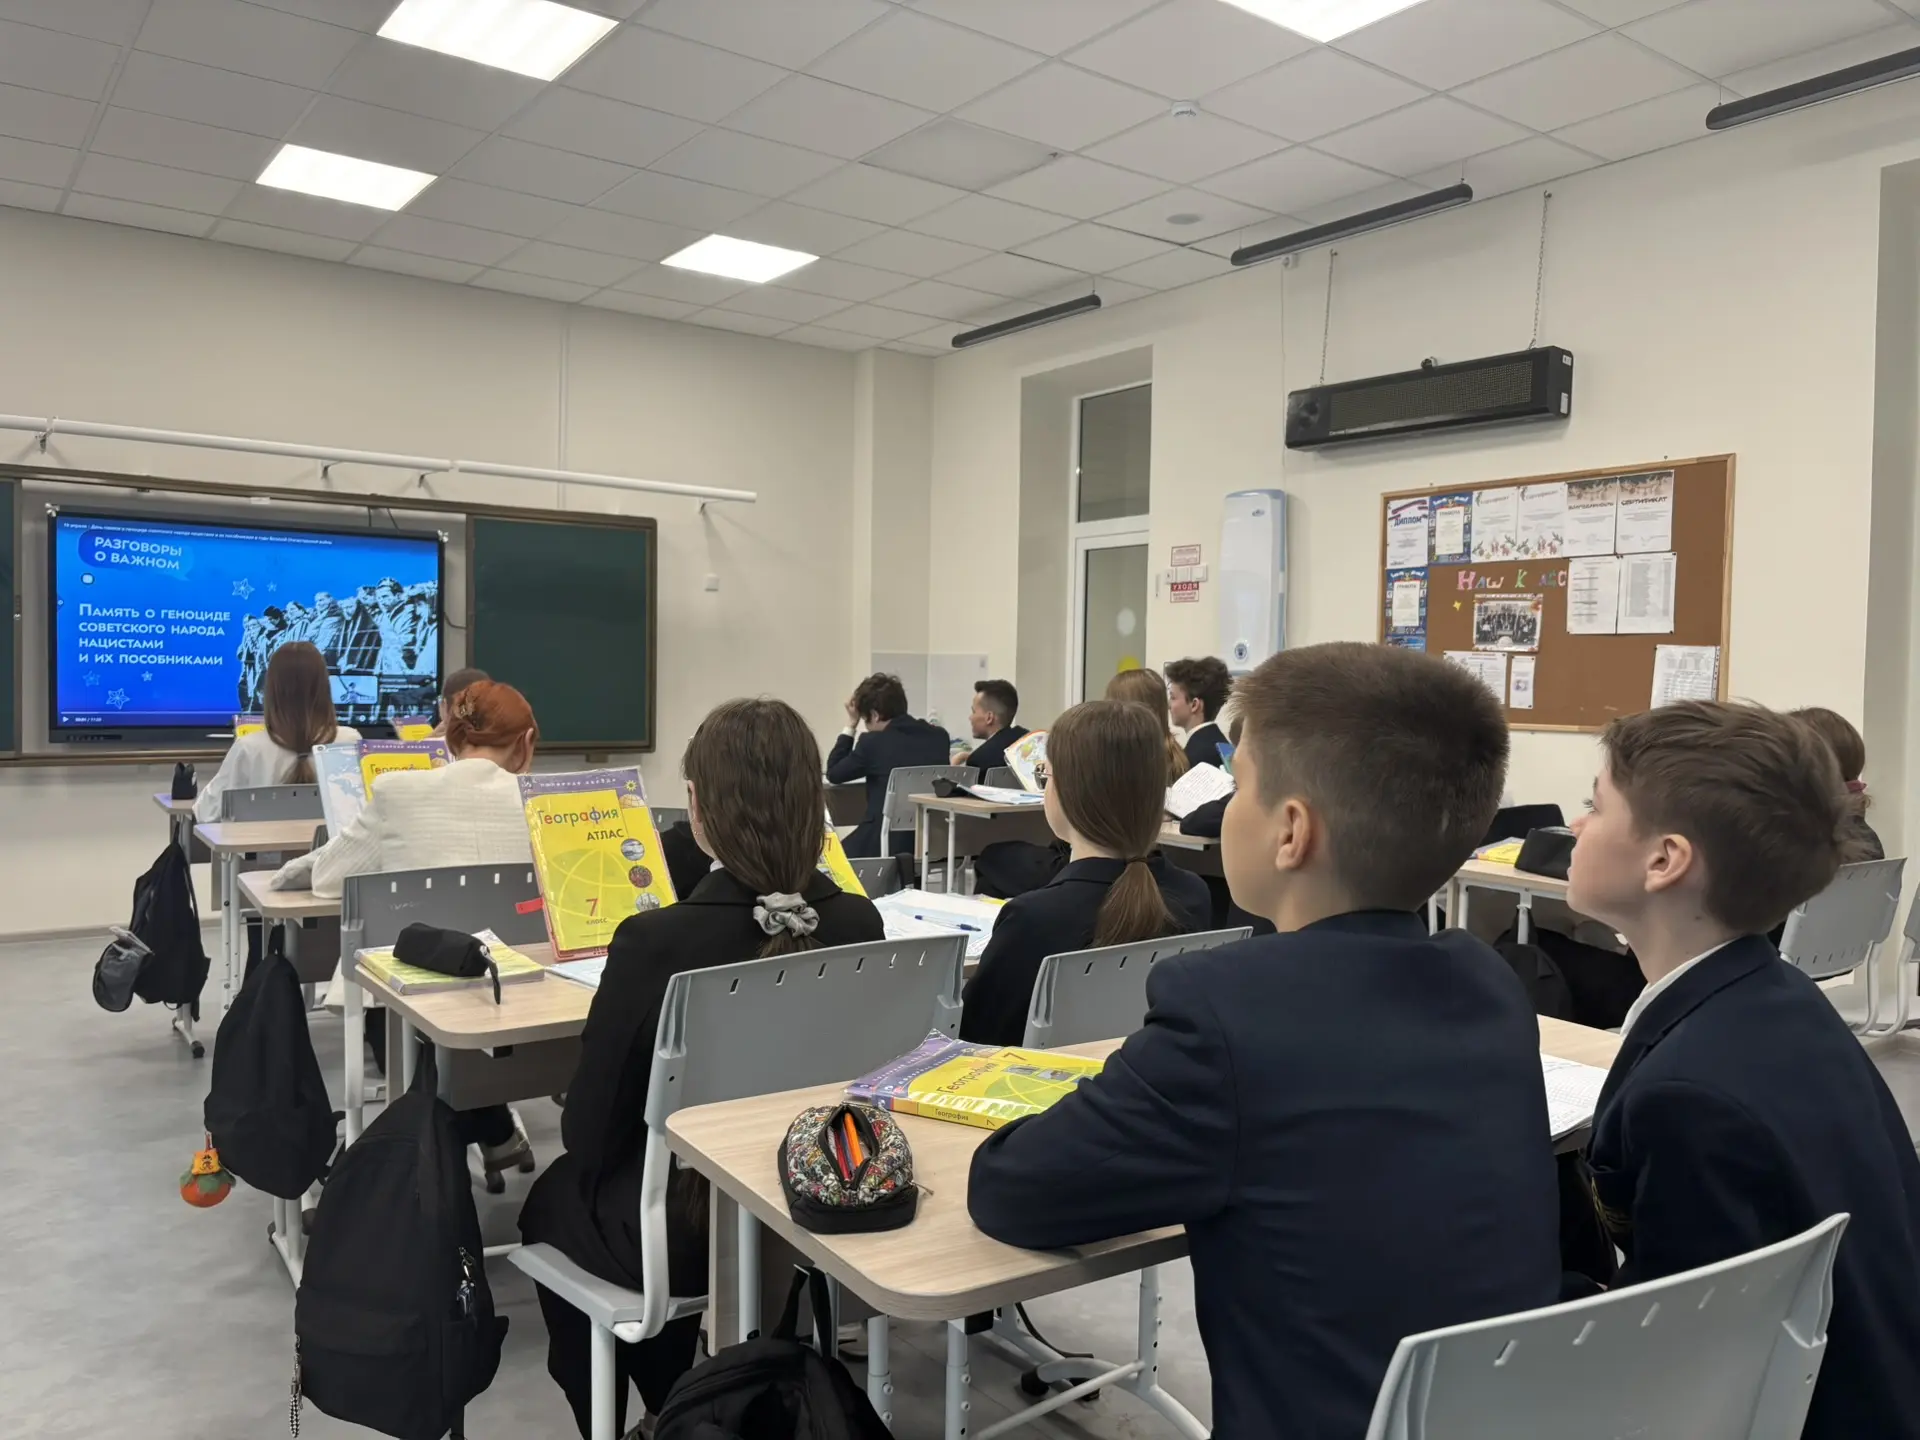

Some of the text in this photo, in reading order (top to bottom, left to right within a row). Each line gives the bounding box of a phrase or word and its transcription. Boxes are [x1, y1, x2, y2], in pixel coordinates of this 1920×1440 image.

[1394, 515, 1422, 527] ДИПЛОМ
[94, 536, 182, 557] РАЗГОВОРЫ
[94, 551, 180, 570] О ВАЖНОМ
[160, 608, 231, 622] ГЕНОЦИДЕ
[78, 622, 226, 637] СОВЕТСКОГО НАРОДА
[78, 637, 164, 650] НАЦИСТАМИ
[78, 653, 223, 666] И ИХ ПОСОБНИКАМИ
[537, 806, 619, 828] География
[586, 829, 625, 842] АТЛАС
[585, 897, 599, 917] 7
[934, 1108, 996, 1127] География 7
